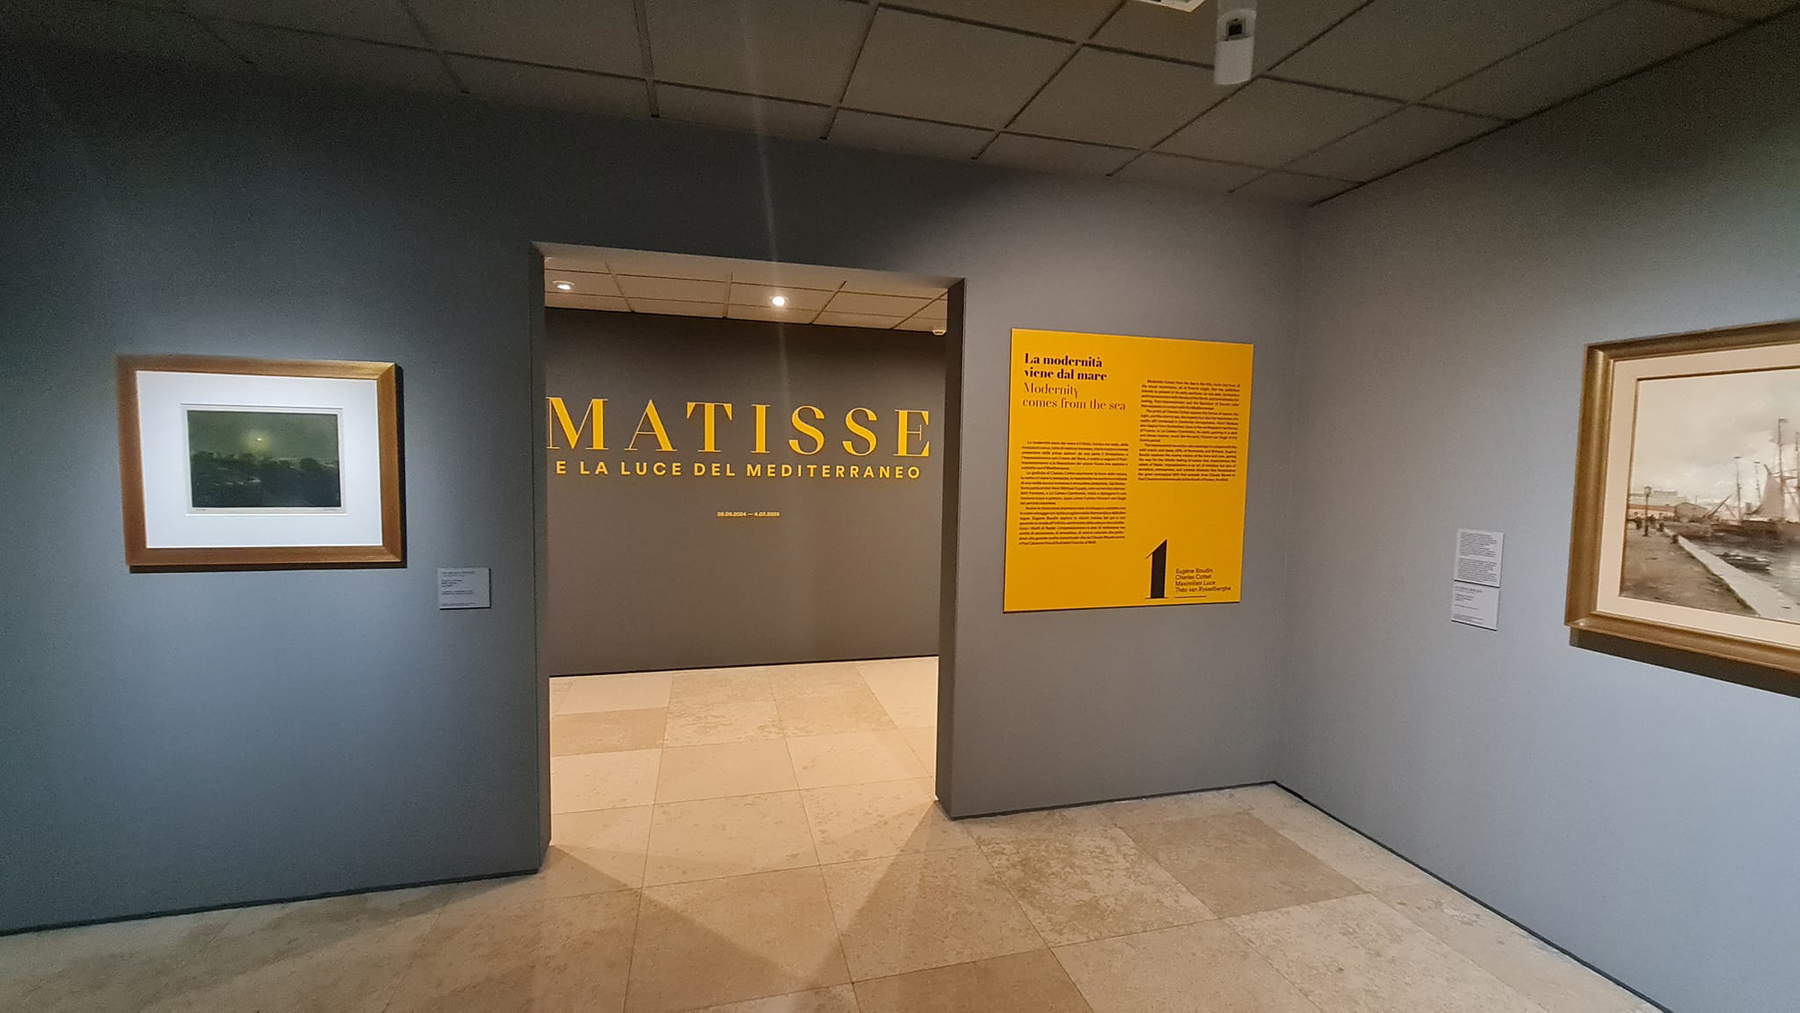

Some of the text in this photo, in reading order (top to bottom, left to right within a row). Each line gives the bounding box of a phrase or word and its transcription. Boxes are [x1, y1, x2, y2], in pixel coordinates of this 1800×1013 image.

[1024, 353, 1103, 368] La modernità
[1024, 366, 1108, 381] viene dal mare
[1024, 382, 1079, 399] Modernity
[1022, 397, 1127, 411] comes from the sea
[545, 396, 931, 457] MATISSE
[556, 460, 921, 479] E LA LUCE DEL MEDITERRANEO
[1145, 539, 1169, 600] 1
